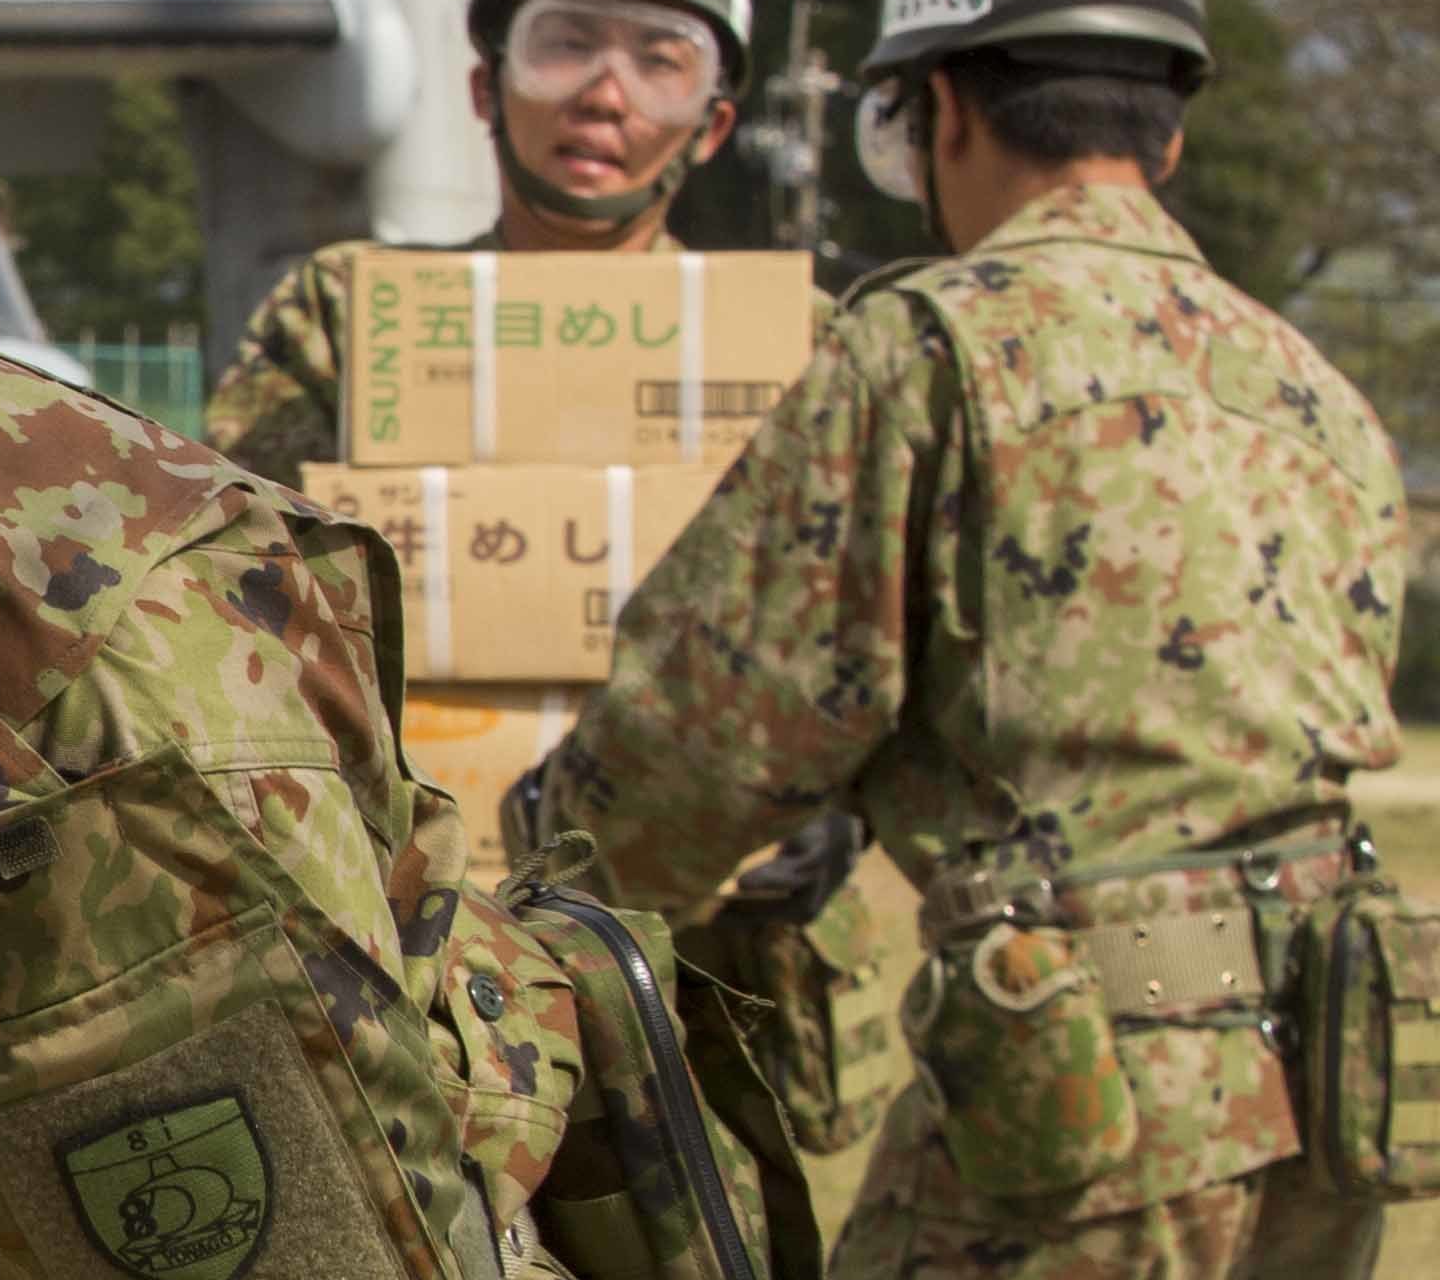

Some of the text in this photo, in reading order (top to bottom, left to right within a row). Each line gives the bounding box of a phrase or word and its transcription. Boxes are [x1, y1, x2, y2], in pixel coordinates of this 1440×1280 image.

[369, 282, 400, 444] SUNYO
[414, 301, 680, 350] 五目めし
